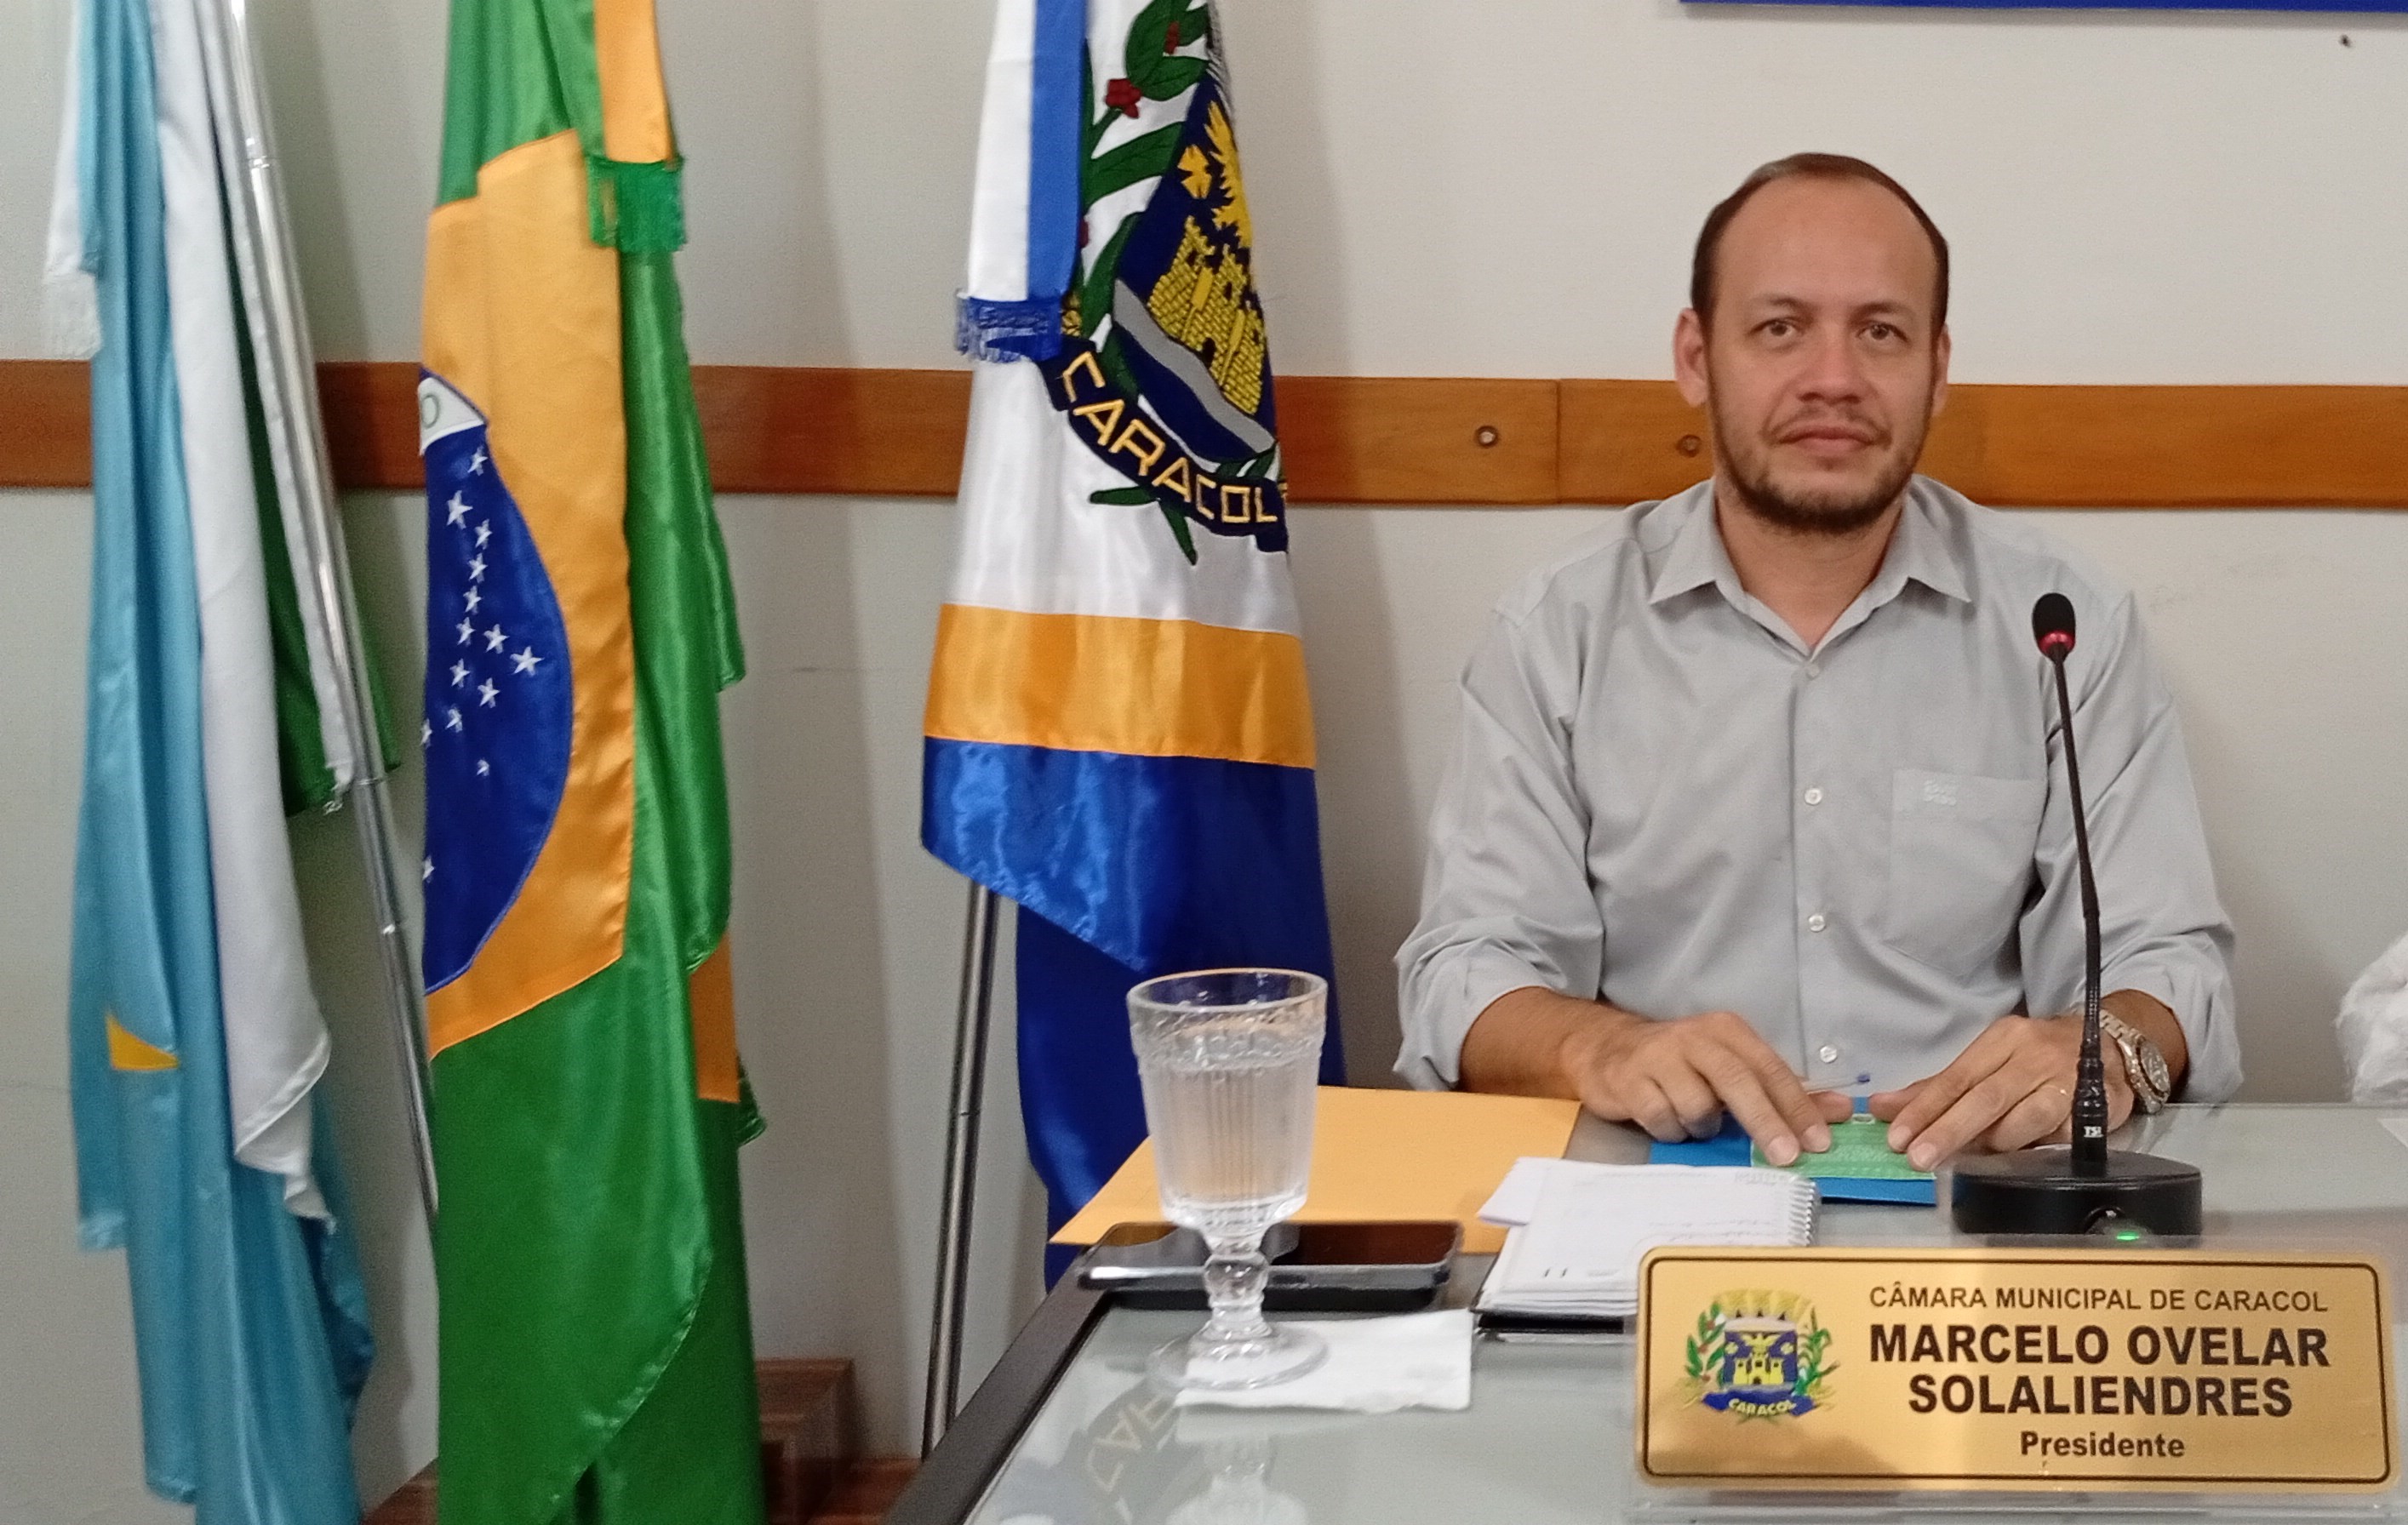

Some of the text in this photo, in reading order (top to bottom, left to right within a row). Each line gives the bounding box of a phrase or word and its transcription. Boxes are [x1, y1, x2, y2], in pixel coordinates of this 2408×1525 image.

[1062, 351, 1278, 523] CARACOL
[1869, 1281, 2329, 1313] CÂMARA MUNICIPAL DE CARACOL
[1870, 1323, 2331, 1368] MARCELO OVELAR
[1728, 1397, 1798, 1417] CARACOL
[1908, 1374, 2293, 1418] SOLALIENDRES
[2020, 1431, 2186, 1458] Presidente
